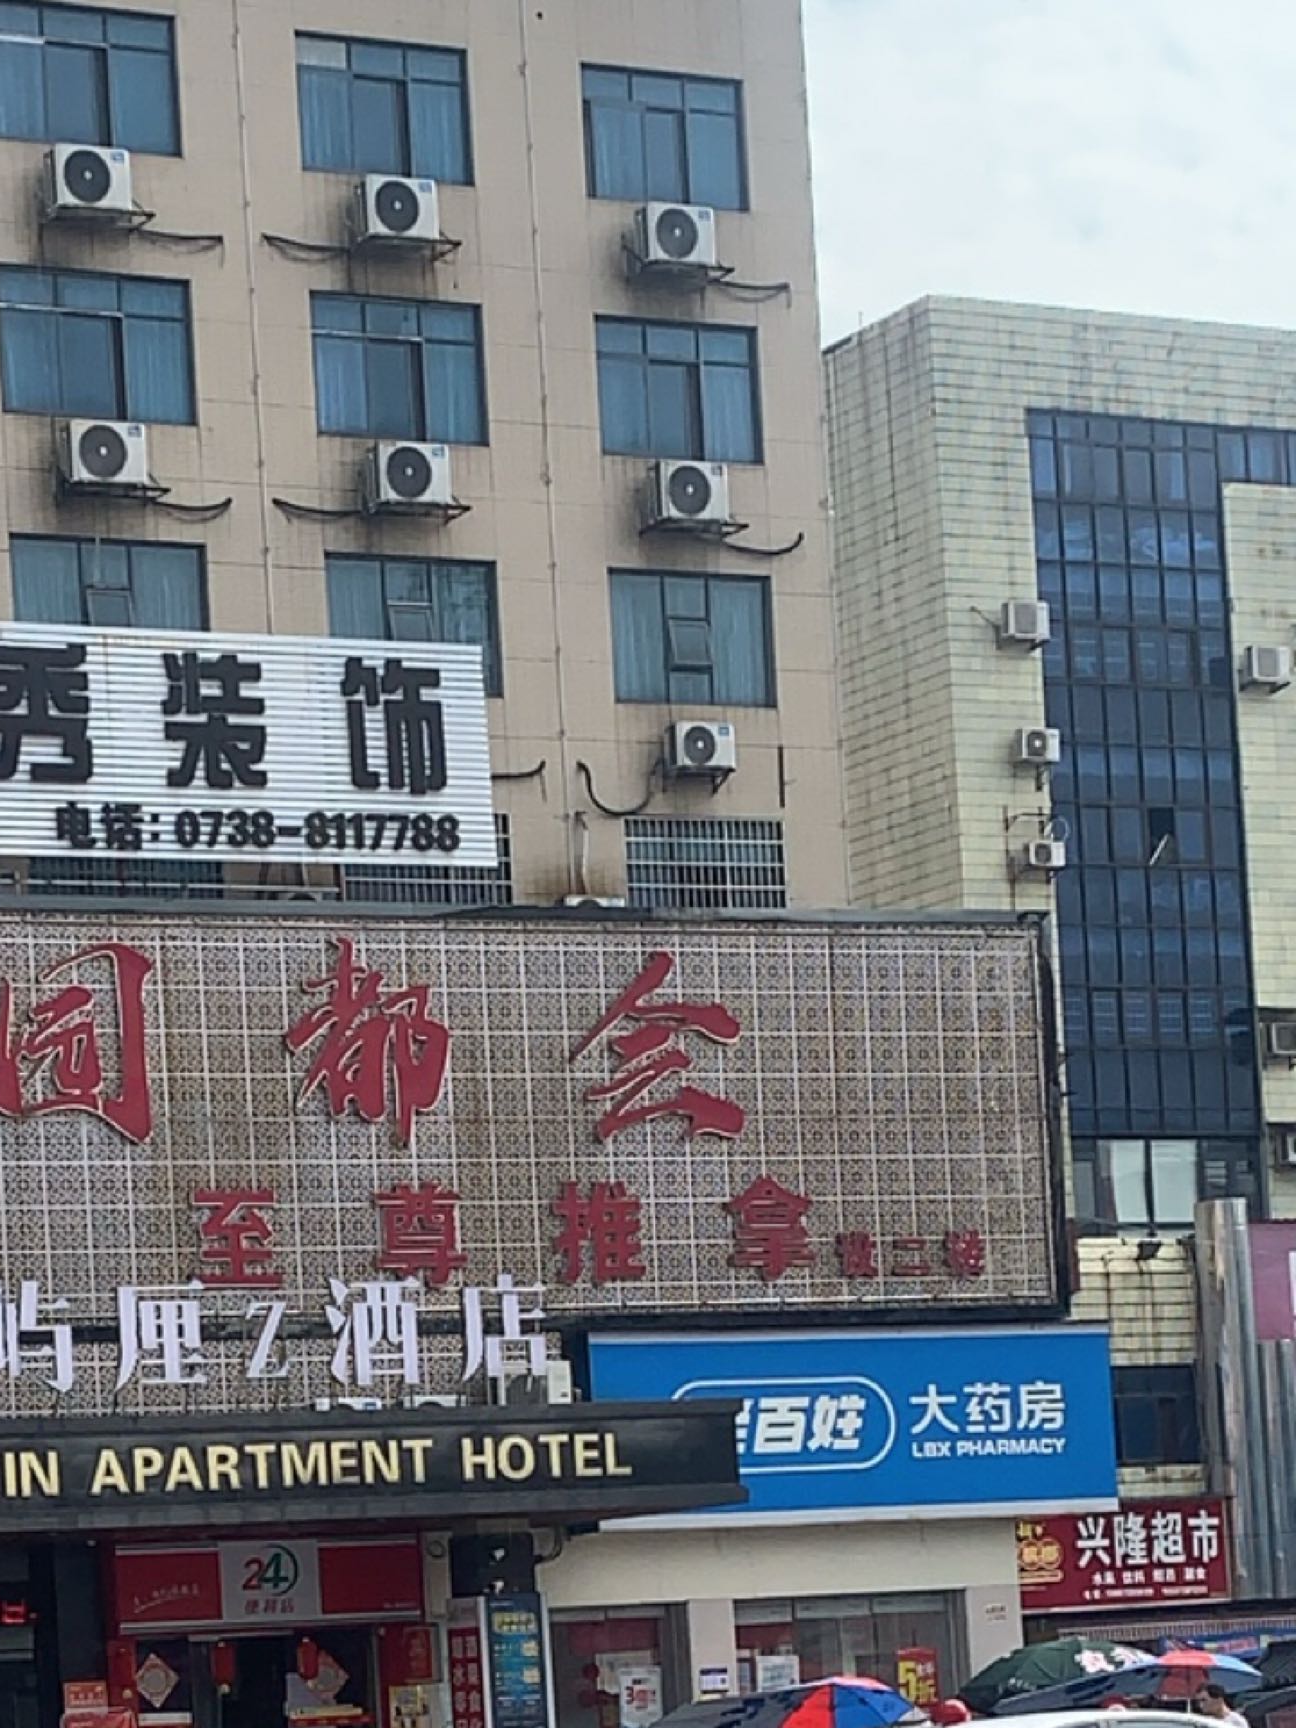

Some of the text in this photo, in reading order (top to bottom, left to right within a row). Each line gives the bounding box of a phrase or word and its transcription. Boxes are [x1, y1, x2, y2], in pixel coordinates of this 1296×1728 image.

[909, 1380, 1067, 1435] 大药房
[90, 1438, 434, 1496] APARTMENT
[461, 1432, 633, 1482] HOTEL
[912, 1438, 1067, 1459] LBX PHARMACY
[1075, 1508, 1220, 1569] 兴隆超市
[242, 1552, 290, 1592] 24
